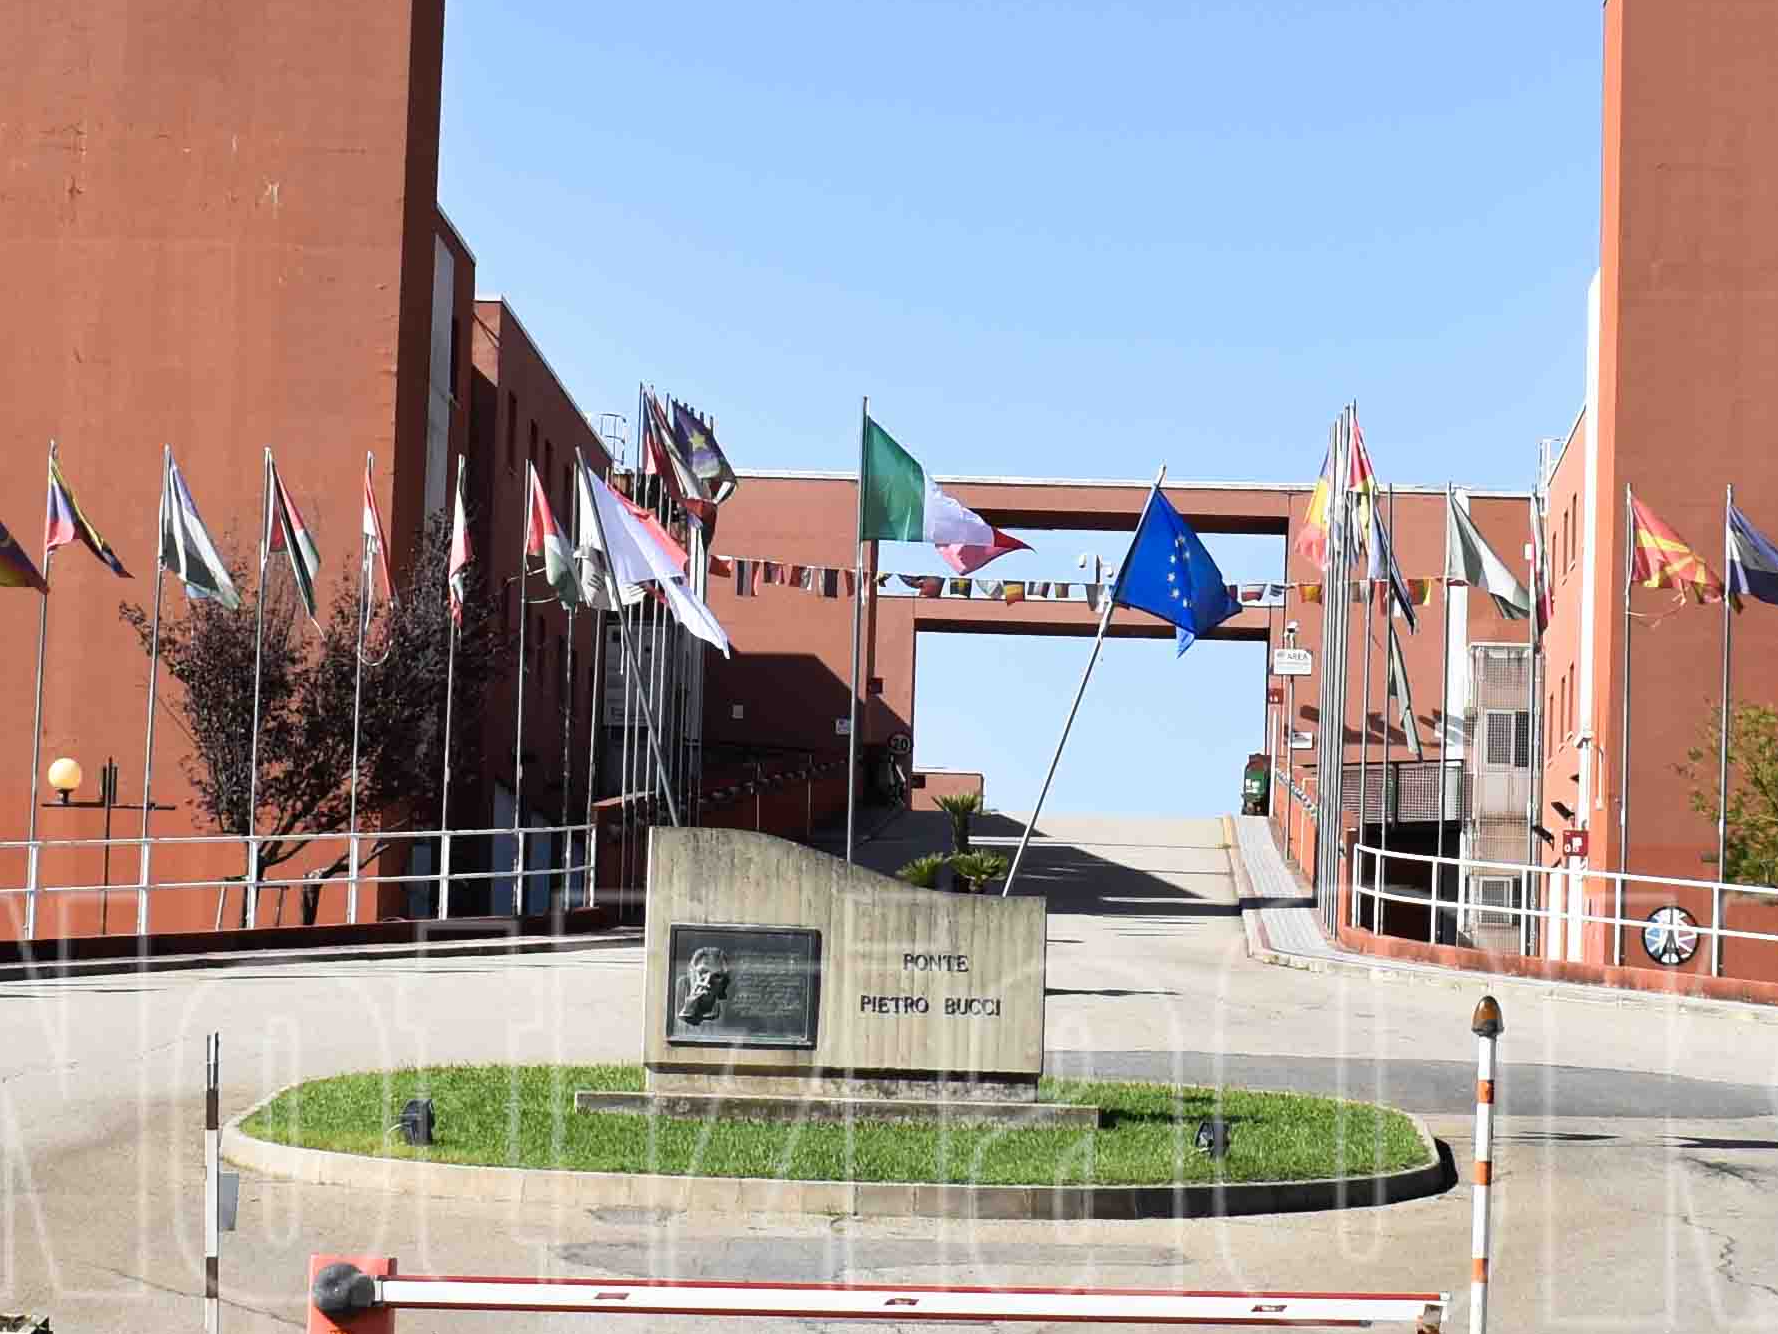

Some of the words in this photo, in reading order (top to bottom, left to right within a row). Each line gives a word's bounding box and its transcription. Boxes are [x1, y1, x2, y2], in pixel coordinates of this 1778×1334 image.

[903, 953, 969, 972] PONTE
[860, 994, 929, 1014] PIETRO
[944, 997, 1001, 1016] BUCCI
